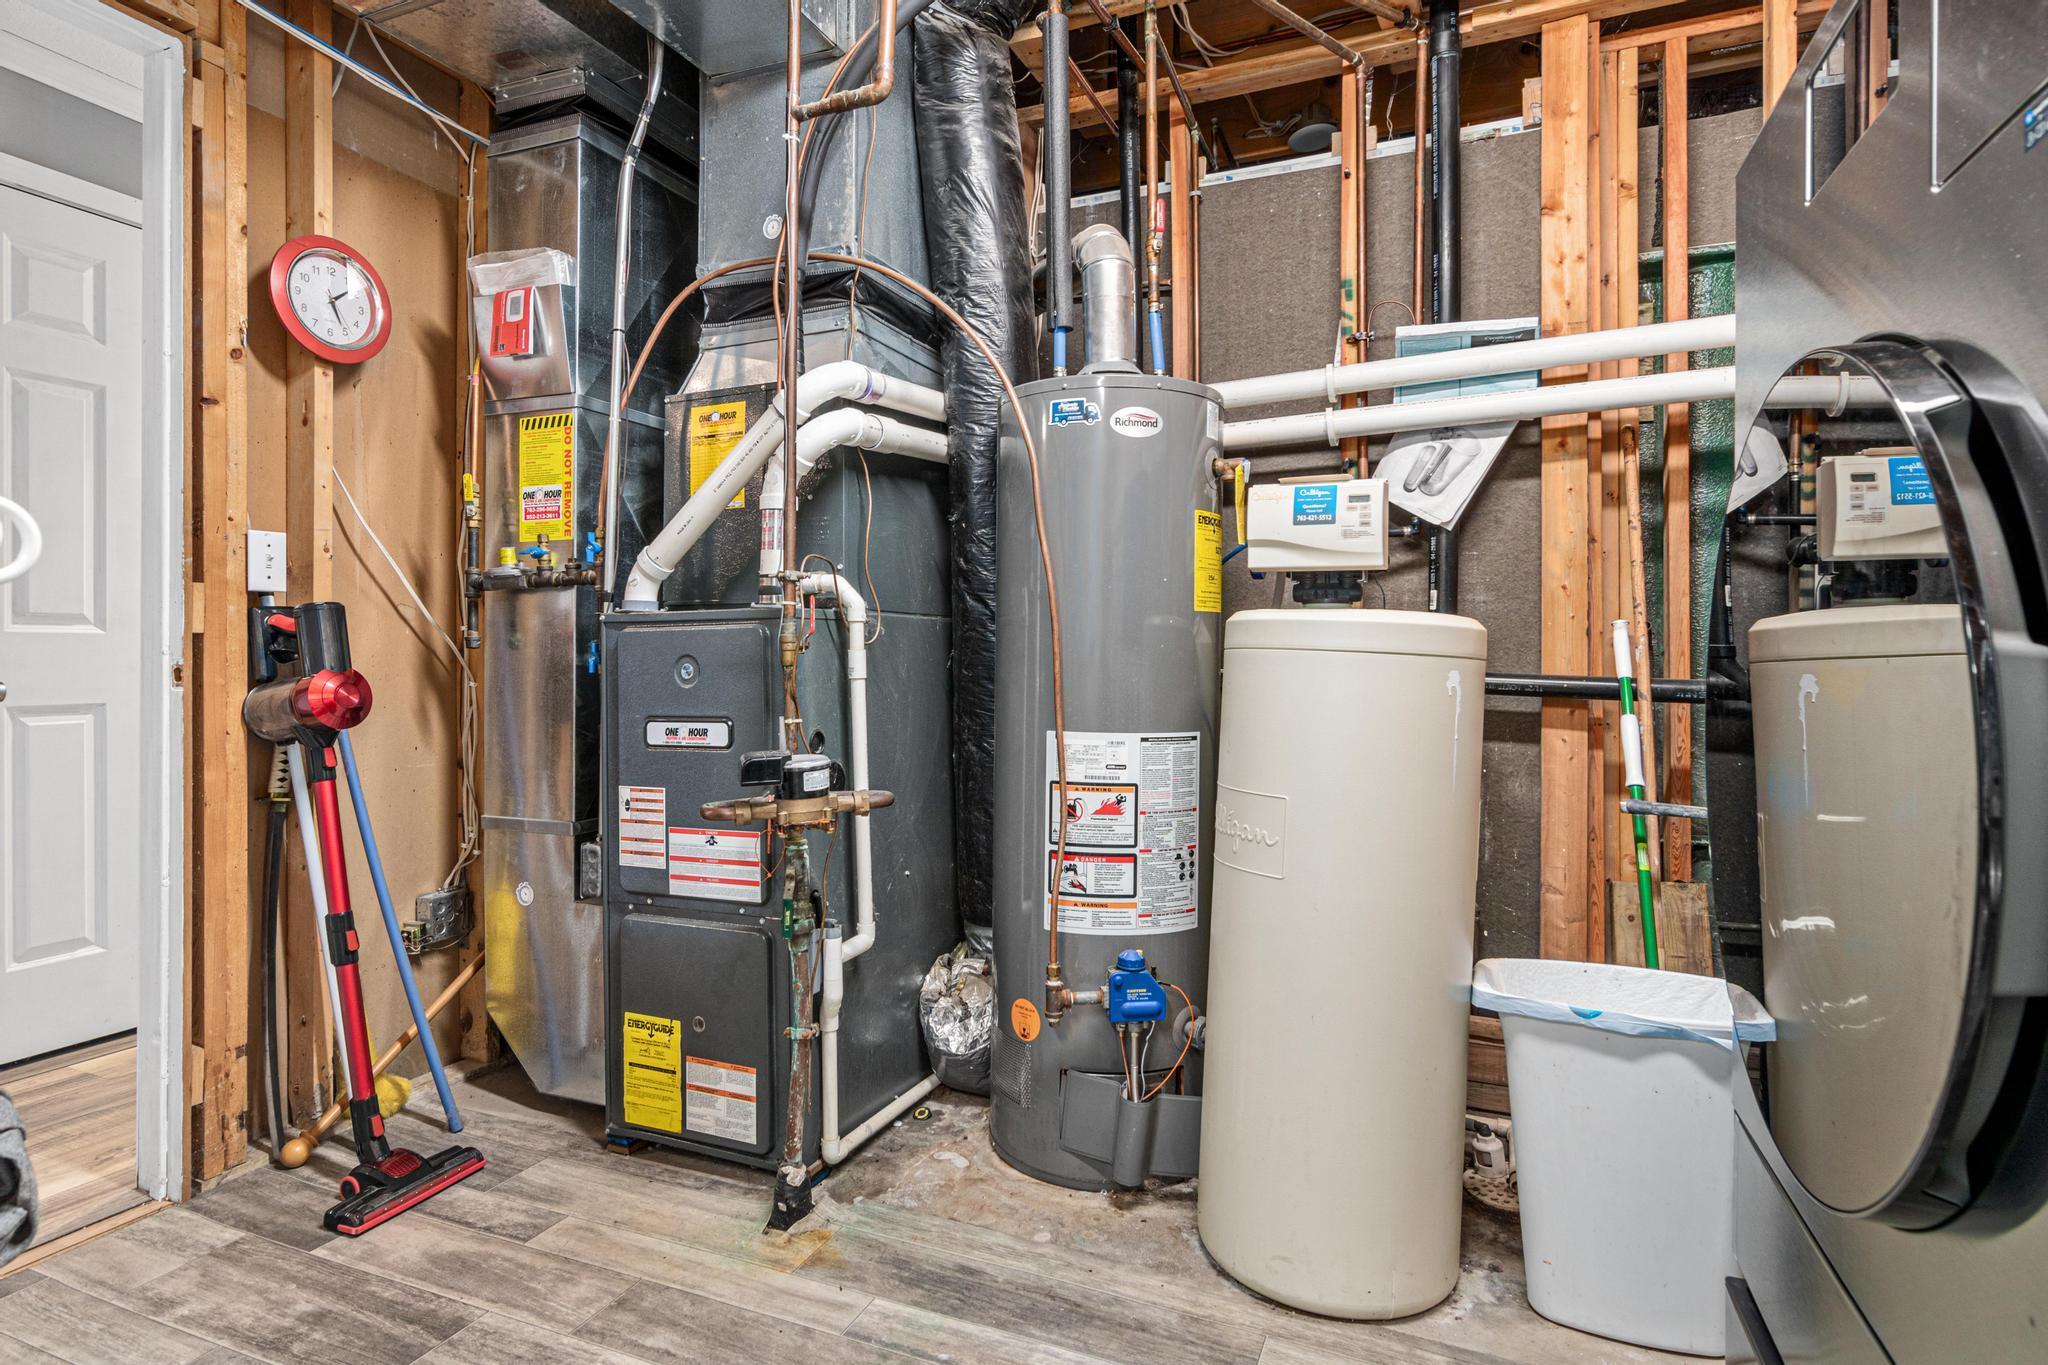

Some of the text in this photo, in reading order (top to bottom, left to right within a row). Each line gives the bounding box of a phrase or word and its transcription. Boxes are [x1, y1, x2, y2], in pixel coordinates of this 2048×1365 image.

[312, 265, 320, 275] 11
[326, 266, 336, 276] 12
[299, 272, 310, 283] 10
[294, 286, 301, 295] 9
[301, 303, 307, 312] 8
[358, 306, 365, 315] 3
[312, 318, 318, 327] 7
[353, 320, 359, 328] 4
[327, 328, 333, 336] 6
[342, 327, 348, 336] 5
[720, 411, 737, 420] HOUR
[1115, 416, 1158, 428] Richmond
[564, 426, 572, 537] DO NOT REMOVE
[523, 489, 562, 500] ONE HOUR
[1299, 488, 1331, 498] Culligan
[665, 728, 708, 737] ONE HOUR
[628, 1019, 674, 1036] ENERGYGUIDE
